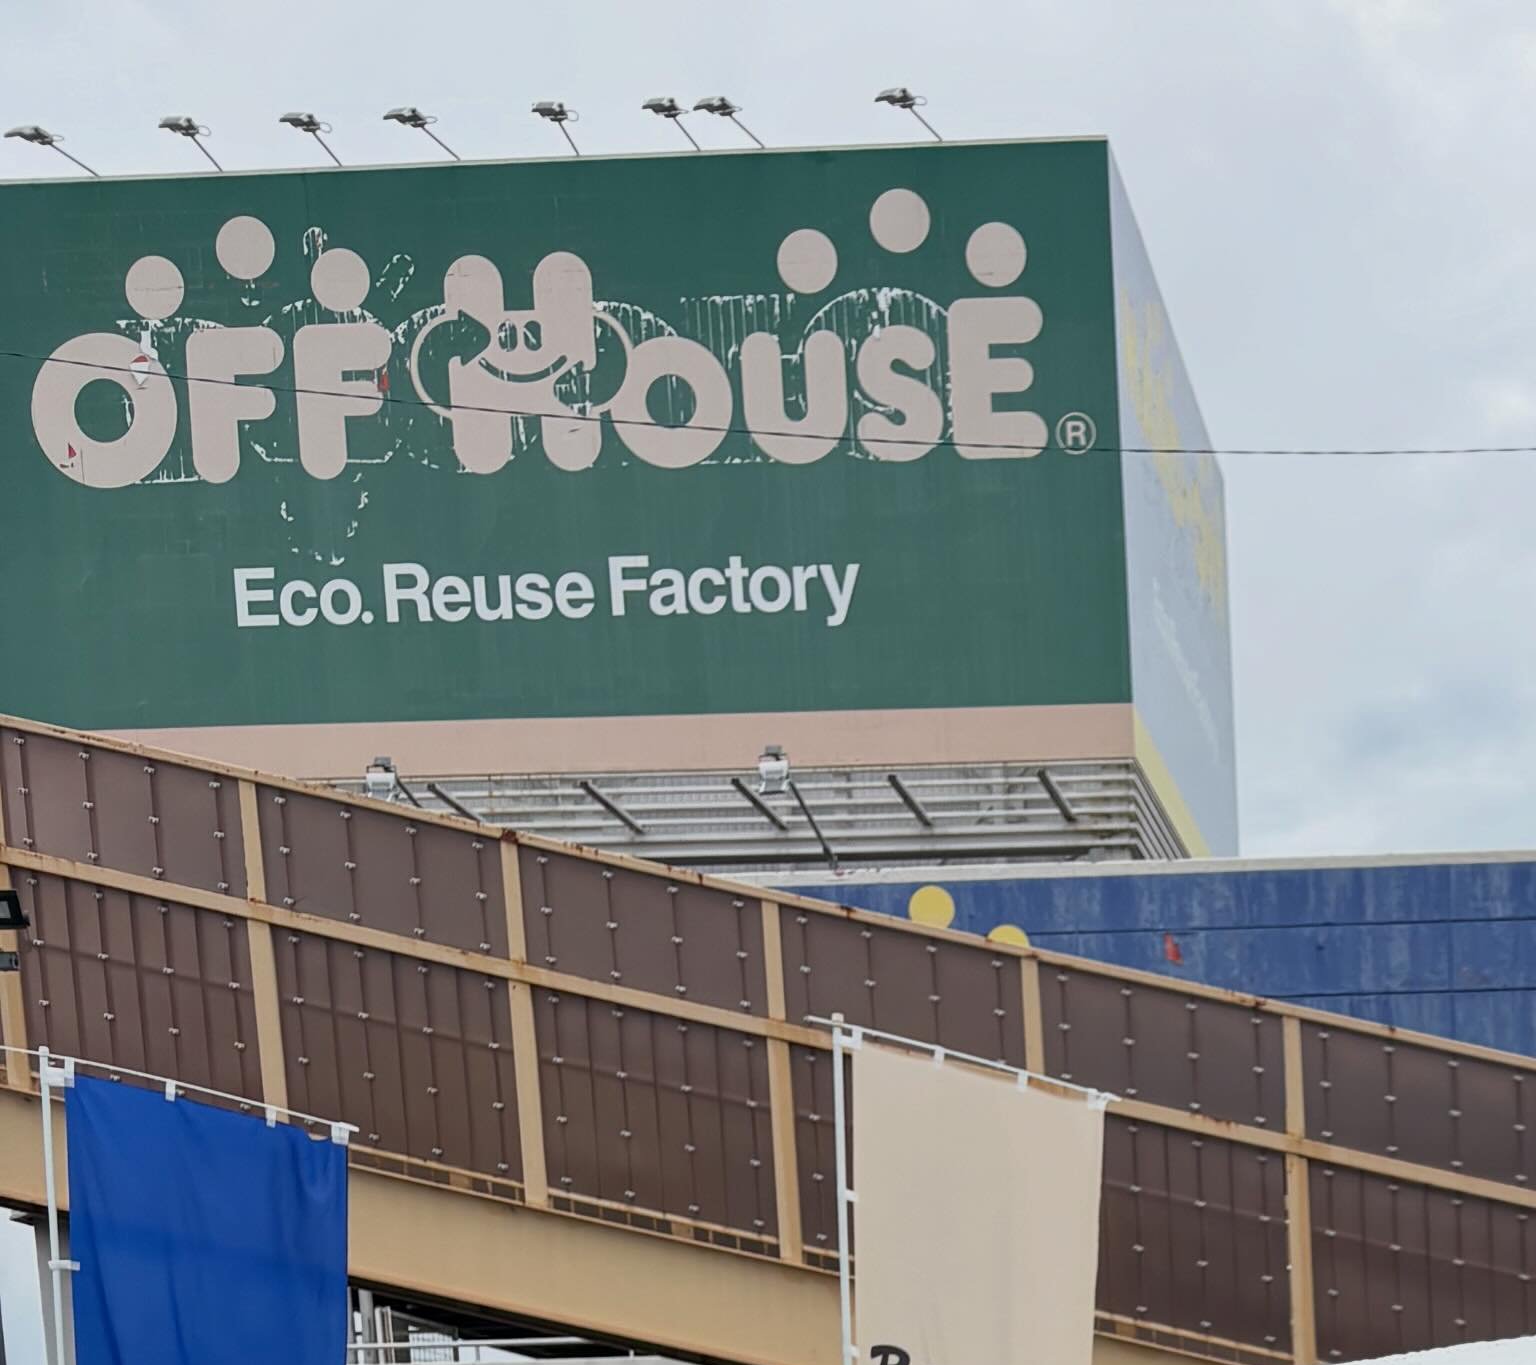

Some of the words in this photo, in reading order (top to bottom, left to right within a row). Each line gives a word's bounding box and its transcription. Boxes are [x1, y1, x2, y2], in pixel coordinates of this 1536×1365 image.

[32, 320, 393, 487] OFF
[444, 250, 1049, 473] HOUSE
[235, 565, 374, 628] Eco.
[385, 561, 595, 623] Reuse
[609, 553, 861, 627] Factory
